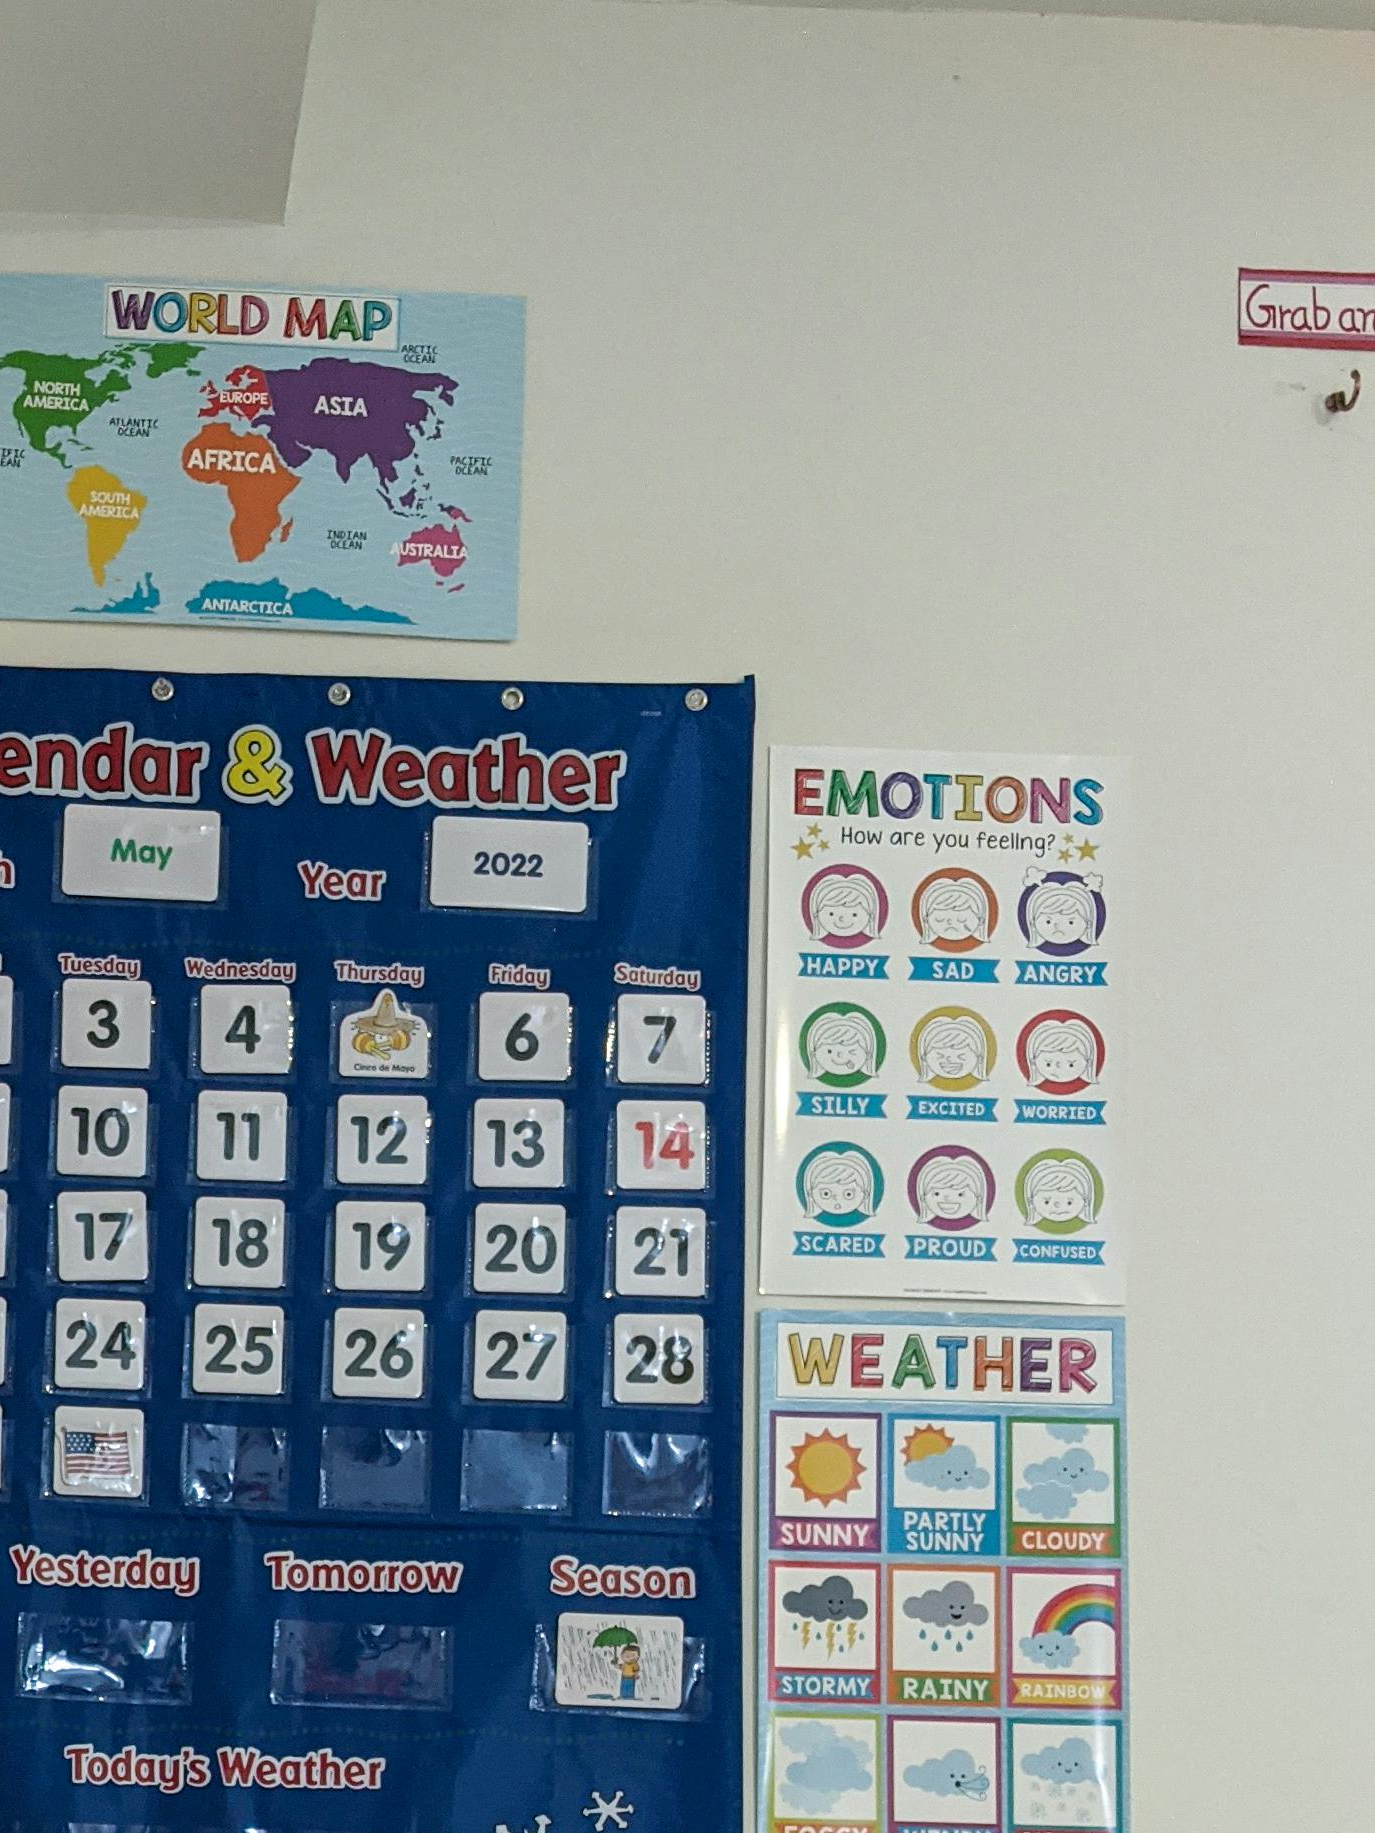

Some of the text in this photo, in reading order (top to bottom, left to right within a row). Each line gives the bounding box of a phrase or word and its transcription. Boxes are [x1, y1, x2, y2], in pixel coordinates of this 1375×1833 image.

[111, 287, 392, 342] WORLD MAP
[1246, 284, 1375, 332] Grab an
[401, 344, 437, 355] ARCTIC
[403, 353, 435, 364] OCEAN
[34, 380, 81, 397] NORTH
[219, 390, 269, 405] EUROPE
[23, 395, 89, 411] AMERICA
[314, 396, 368, 418] ASIA
[109, 417, 159, 430] ATLANTIC
[116, 425, 151, 437] OCEAN
[187, 448, 277, 474] AFRICA
[450, 455, 493, 467] PACIFIC
[455, 464, 488, 476] OCEAN
[89, 490, 131, 506] SOUTH
[79, 504, 140, 519] AMERICA
[327, 529, 368, 541] INDIAN
[330, 539, 363, 550] OCEAN
[390, 542, 468, 560] AUSTRALIA
[202, 597, 293, 616] ANTARCTICA
[221, 724, 293, 806] &
[309, 727, 627, 814] Weather
[793, 767, 1104, 827] EMOTIONS
[841, 826, 1056, 858] How are you feeling?
[110, 837, 173, 872] May
[473, 851, 544, 878] 2022
[298, 860, 386, 902] Year
[59, 953, 141, 980] Tuesday
[186, 956, 296, 983] Wednesday
[334, 959, 424, 988] Thursday
[489, 963, 550, 990] Friday
[614, 961, 701, 992] Saturday
[806, 956, 880, 979] HAPPY
[931, 959, 975, 981] SAD
[1023, 963, 1098, 985] ANGRY
[86, 999, 121, 1049] 3
[224, 1004, 261, 1054] 4
[504, 1012, 540, 1062] 6
[644, 1016, 676, 1063] 7
[354, 1063, 376, 1071] Cinco
[392, 1064, 414, 1073] Mayo
[811, 1095, 871, 1117] SILLY
[918, 1100, 985, 1117] EXCITED
[1022, 1105, 1098, 1122] WORRIED
[71, 1107, 129, 1156] 10
[217, 1112, 259, 1160] 11
[351, 1116, 407, 1164] 12
[487, 1120, 544, 1167] 13
[636, 1122, 694, 1169] 14
[212, 1219, 268, 1267] 18
[485, 1225, 556, 1273] 20
[801, 1234, 876, 1255] SCARED
[913, 1236, 987, 1259] PROUD
[1019, 1243, 1098, 1261] CONFUSED
[205, 1325, 273, 1374] 25
[787, 1332, 1098, 1394] WEATHER
[903, 1511, 986, 1533] PARTLY
[780, 1523, 870, 1547] SUNNY
[905, 1531, 984, 1553] SUNNY
[1021, 1530, 1105, 1552] CLOUDY
[9, 1544, 200, 1597] Yesterday
[264, 1551, 464, 1594] Tomorrow
[549, 1555, 697, 1600] Season
[781, 1676, 871, 1698] STORMY
[902, 1678, 989, 1702] RAINY
[1020, 1683, 1107, 1700] RAINBOW
[64, 1744, 386, 1793] Today's Weather
